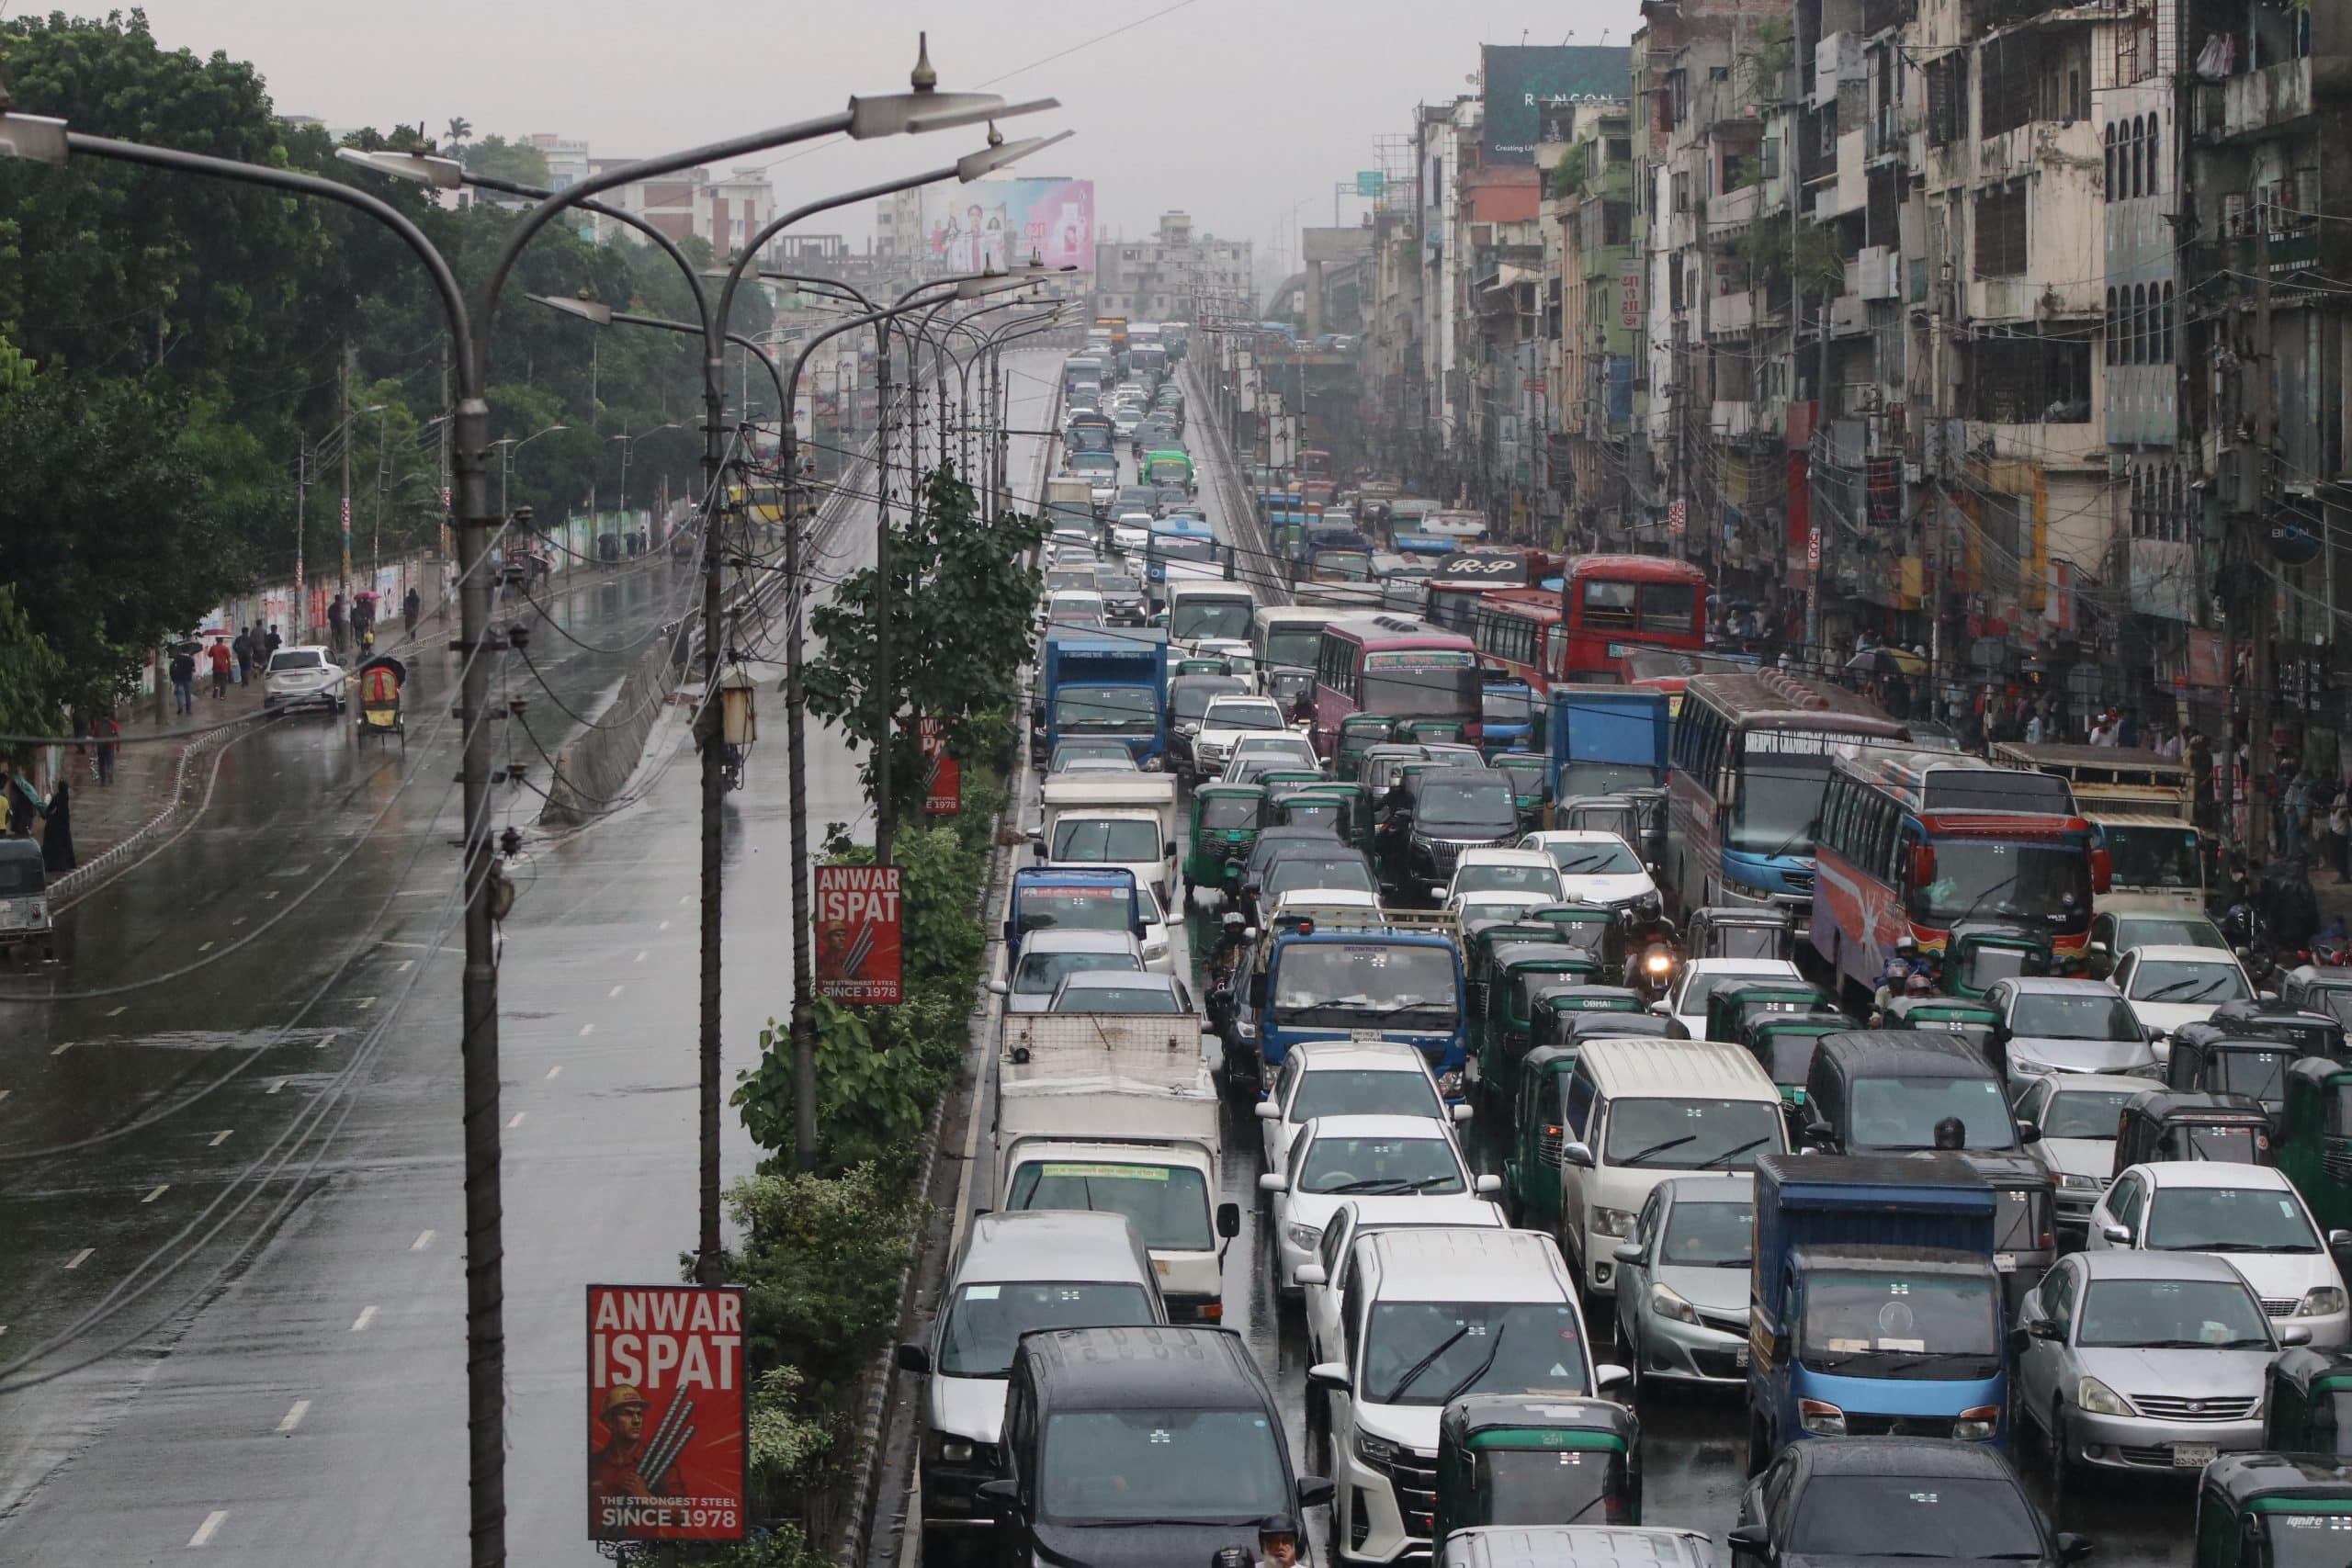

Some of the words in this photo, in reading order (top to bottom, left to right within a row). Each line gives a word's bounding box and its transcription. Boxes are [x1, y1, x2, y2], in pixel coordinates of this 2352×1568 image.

[1447, 558, 1517, 574] R-P
[819, 868, 899, 891] ANWAR
[818, 891, 899, 923] ISPAT
[822, 987, 862, 998] SINCE
[866, 987, 898, 998] 1978
[595, 1292, 741, 1332] ANWAR
[594, 1334, 741, 1390] ISPAT
[600, 1495, 624, 1506] THE
[626, 1495, 697, 1507] STRONGEST
[701, 1497, 737, 1507] STEEL
[602, 1508, 672, 1528] SINCE
[681, 1509, 736, 1529] 1978
